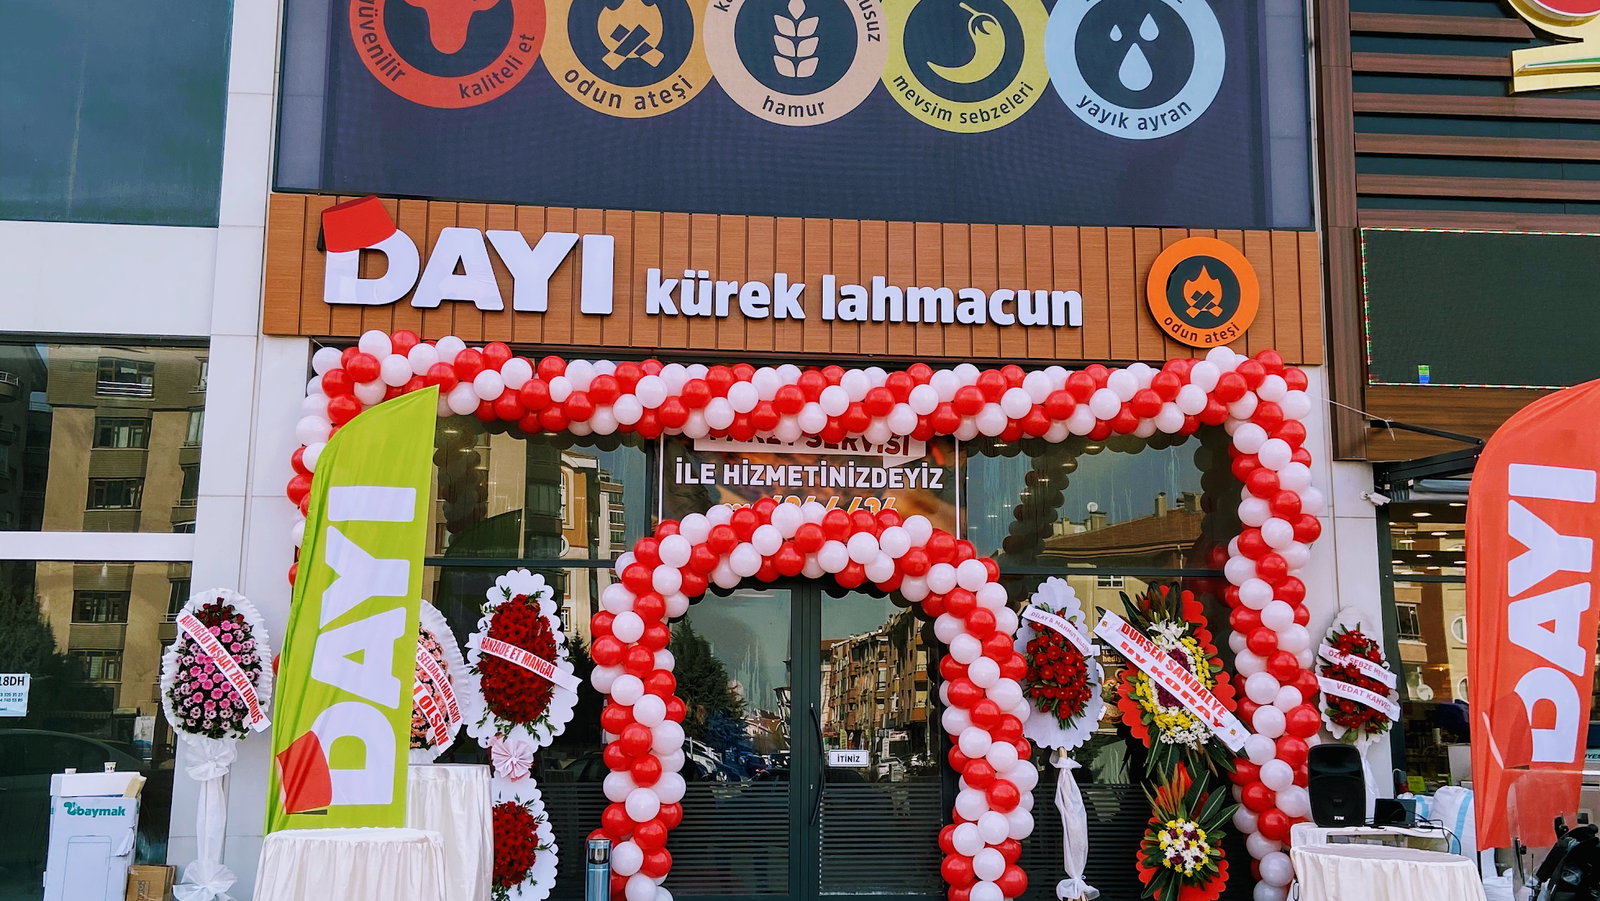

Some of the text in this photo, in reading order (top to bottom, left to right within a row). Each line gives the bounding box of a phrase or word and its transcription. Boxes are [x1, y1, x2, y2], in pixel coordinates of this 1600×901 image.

[458, 33, 535, 99] kaliteli et
[564, 69, 693, 111] odun ateşi
[762, 95, 825, 118] hamur
[893, 75, 1034, 124] mevsim sebzeleri
[1076, 94, 1192, 132] yayık ayran
[323, 226, 615, 316] DAYI
[645, 268, 1083, 328] kürek lahmacun
[1164, 316, 1240, 344] odun ateşi
[675, 456, 944, 489] İLE HİZMETİNİZDEYİZ
[1508, 463, 1597, 764] DAYI
[311, 486, 417, 806] DAYI
[509, 647, 523, 661] ET
[521, 652, 556, 679] MANGAL
[1349, 657, 1374, 672] SEBZE
[1120, 623, 1228, 718] DURSEN SANDALYE
[1336, 682, 1364, 697] VEDAT
[1150, 665, 1225, 728] KORAY
[418, 694, 450, 746] OLSUN
[837, 753, 861, 763] İTİNİZ
[74, 803, 126, 818] baymak
